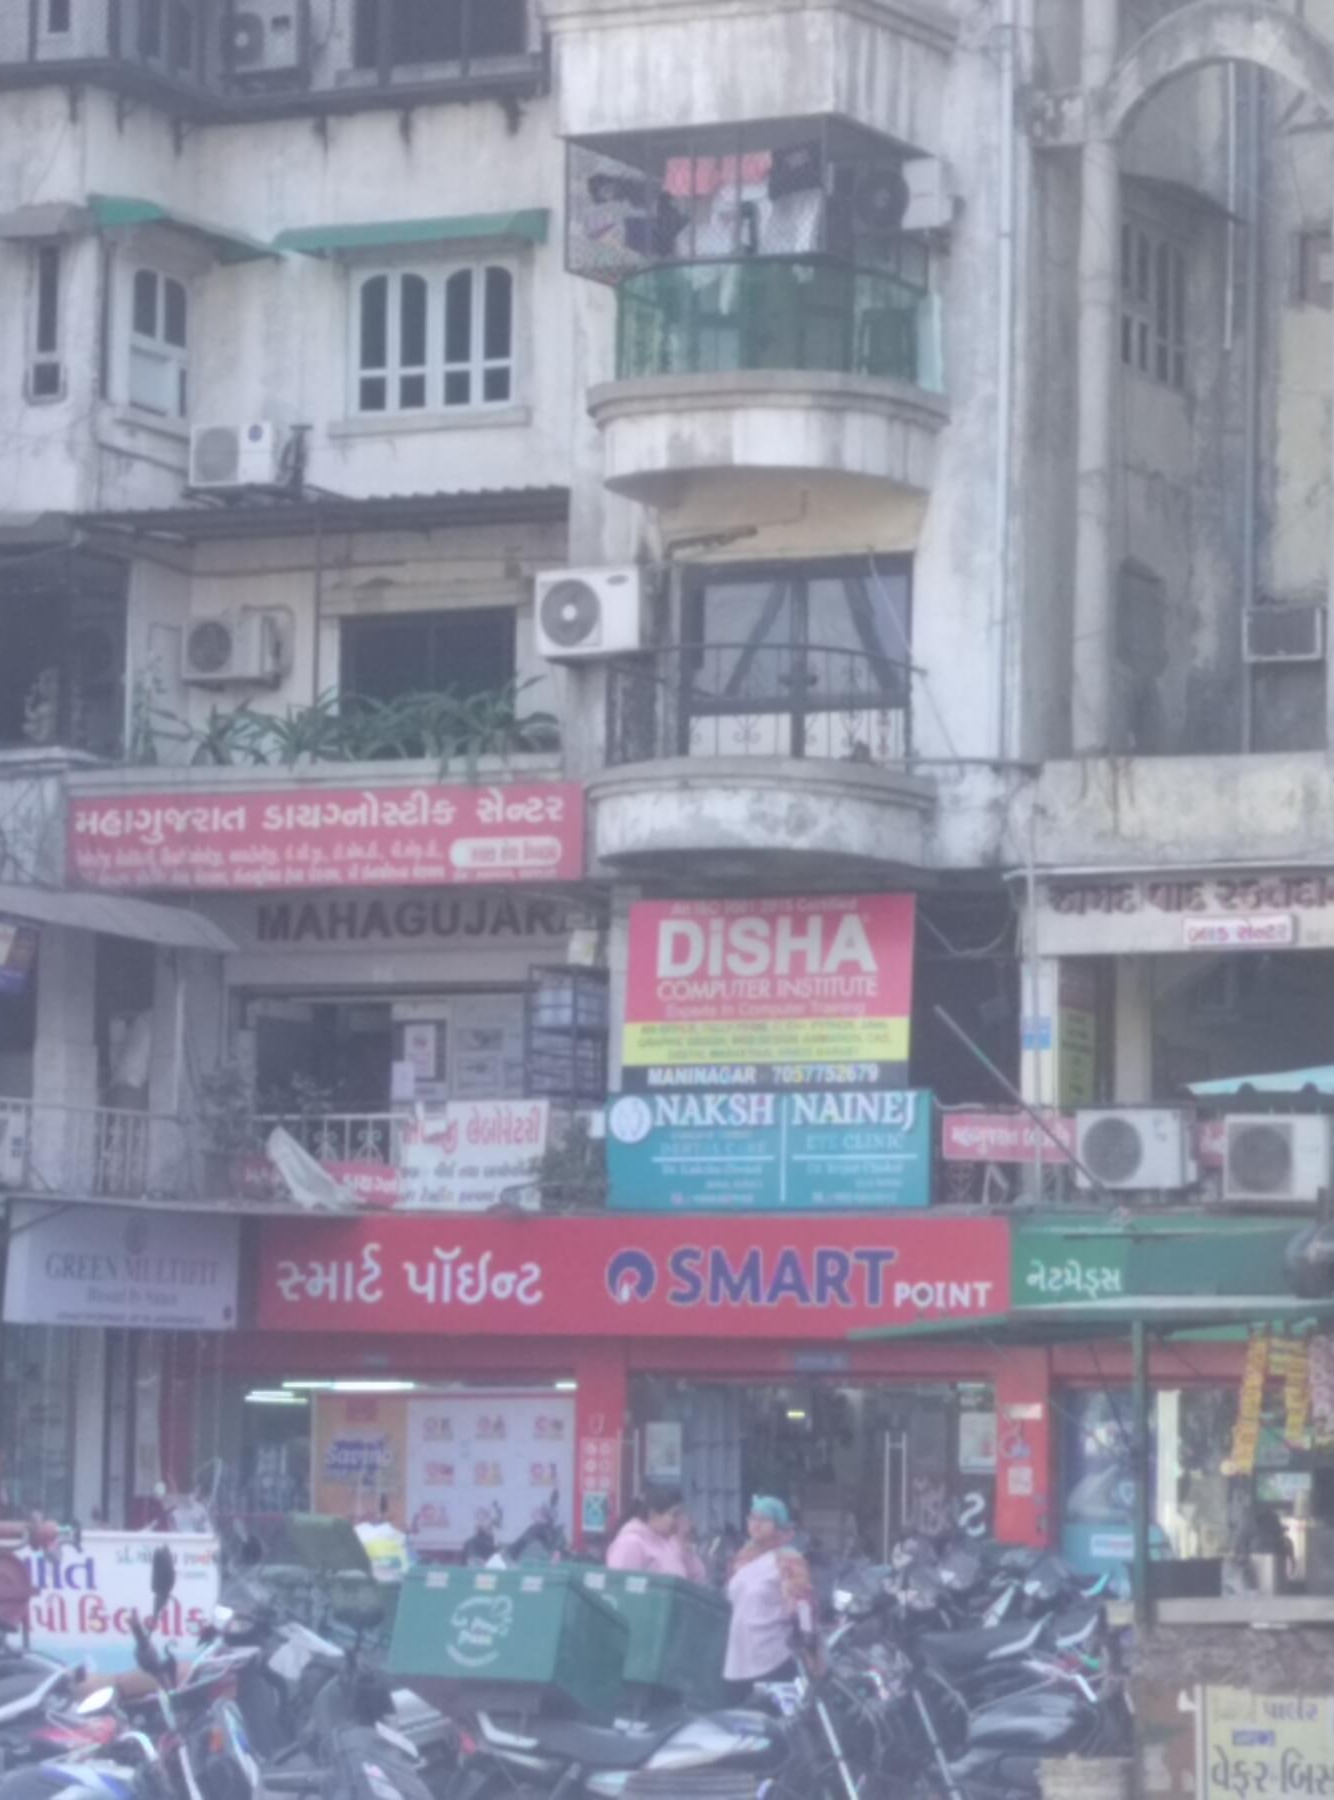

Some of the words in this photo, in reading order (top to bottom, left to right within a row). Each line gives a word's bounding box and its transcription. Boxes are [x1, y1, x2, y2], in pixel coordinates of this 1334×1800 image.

[73, 803, 247, 844] મહાગુજરાત
[475, 787, 565, 828] સેન્ટર
[256, 902, 567, 943] MAHAGUJAR
[656, 979, 772, 1001] COMPUTER
[775, 975, 879, 998] INSTITUTE
[647, 1066, 758, 1087] MANINAGAR
[654, 1092, 775, 1127] NAKSH
[791, 1090, 918, 1132] NAINEJ
[842, 1131, 906, 1151] CLINIC
[275, 1240, 385, 1303] સ્માર્ટ
[667, 1244, 900, 1309] SMART
[892, 1280, 995, 1311] POINT
